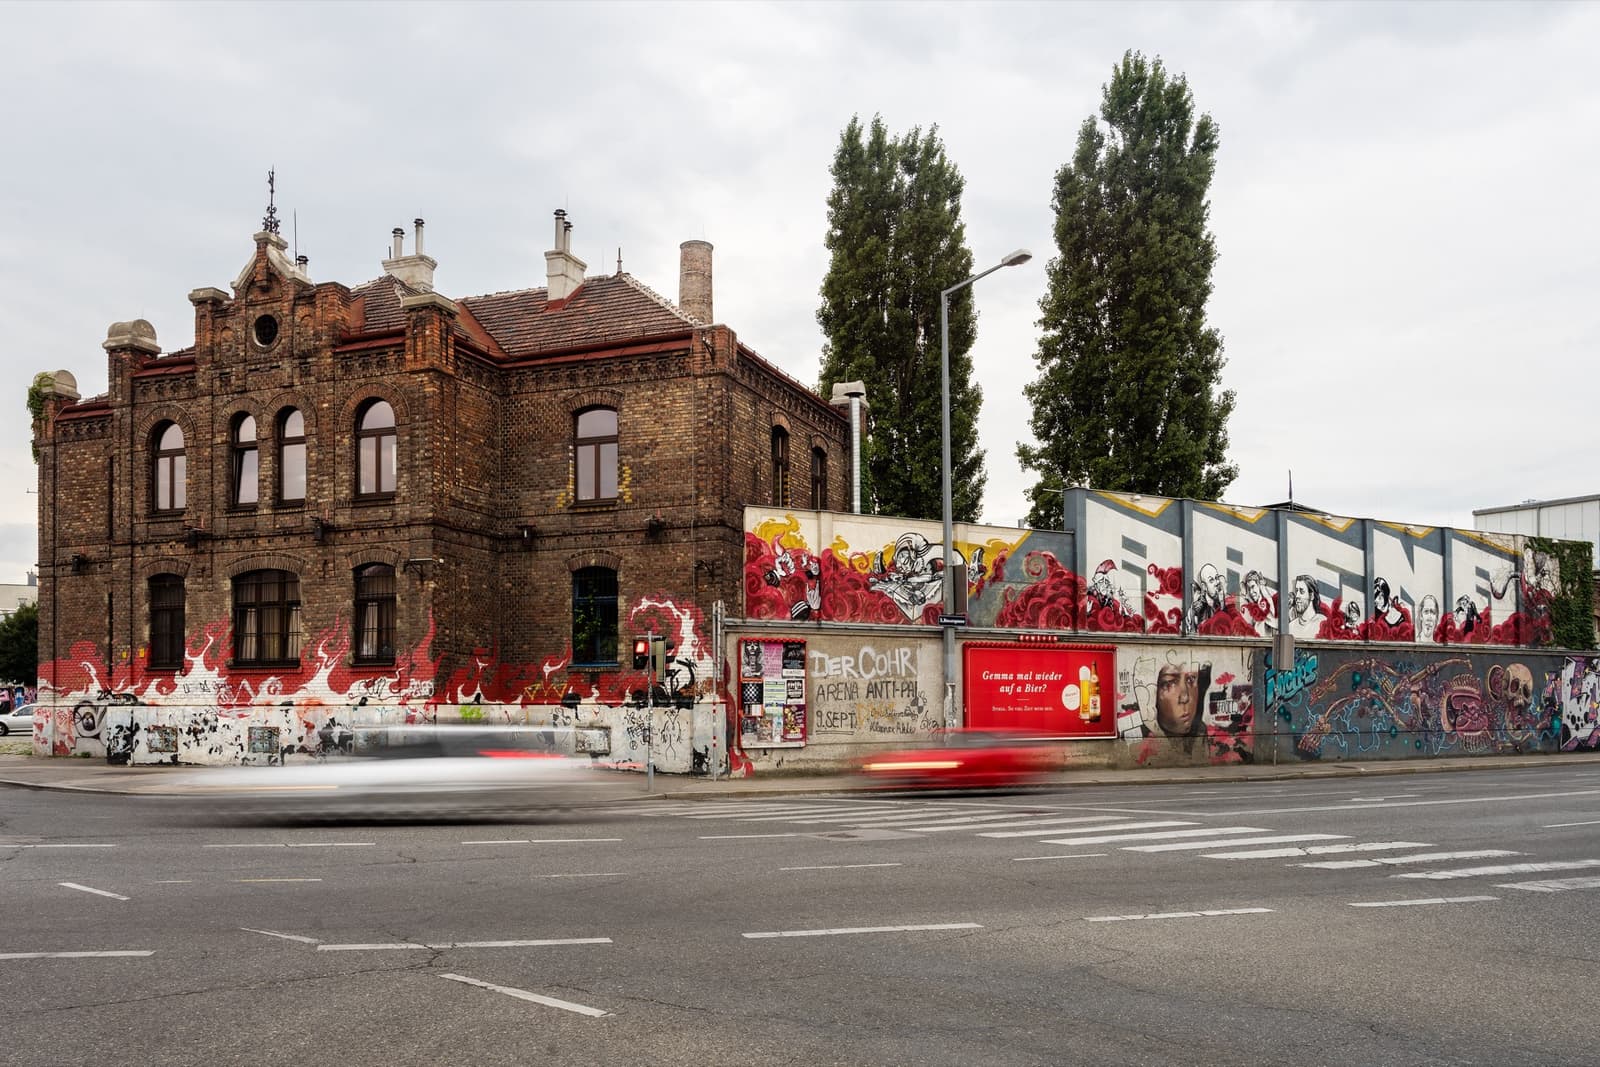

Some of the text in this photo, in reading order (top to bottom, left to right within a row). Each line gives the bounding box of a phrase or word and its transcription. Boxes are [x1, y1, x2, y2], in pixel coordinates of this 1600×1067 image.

[982, 670, 1063, 680] Gemma mal wieder
[816, 682, 859, 703] ARENA
[999, 683, 1016, 695] auf
[1024, 683, 1047, 693] Bier?
